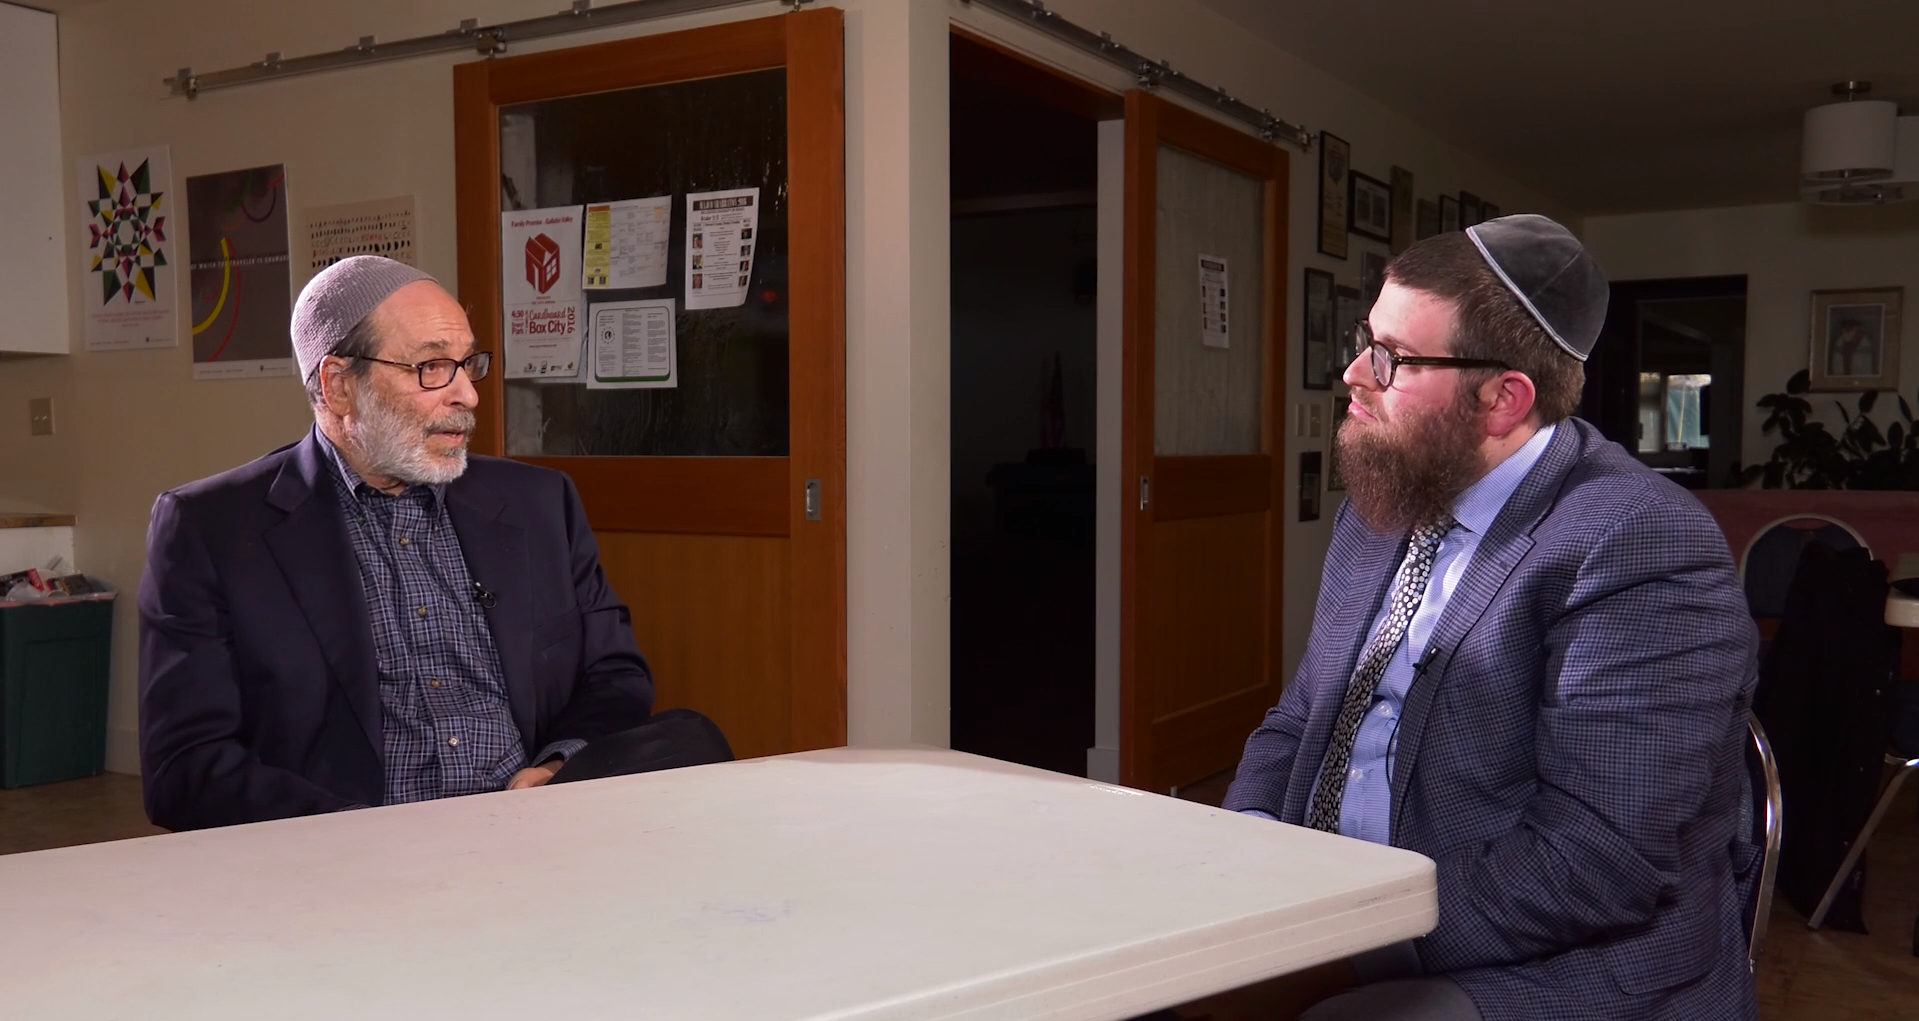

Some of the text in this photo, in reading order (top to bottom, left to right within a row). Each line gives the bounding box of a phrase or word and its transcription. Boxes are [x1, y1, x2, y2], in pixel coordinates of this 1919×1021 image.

[529, 307, 566, 320] Cardboard
[567, 306, 575, 334] 2016
[511, 326, 524, 335] Park
[529, 321, 547, 334] Box
[548, 320, 566, 335] City
